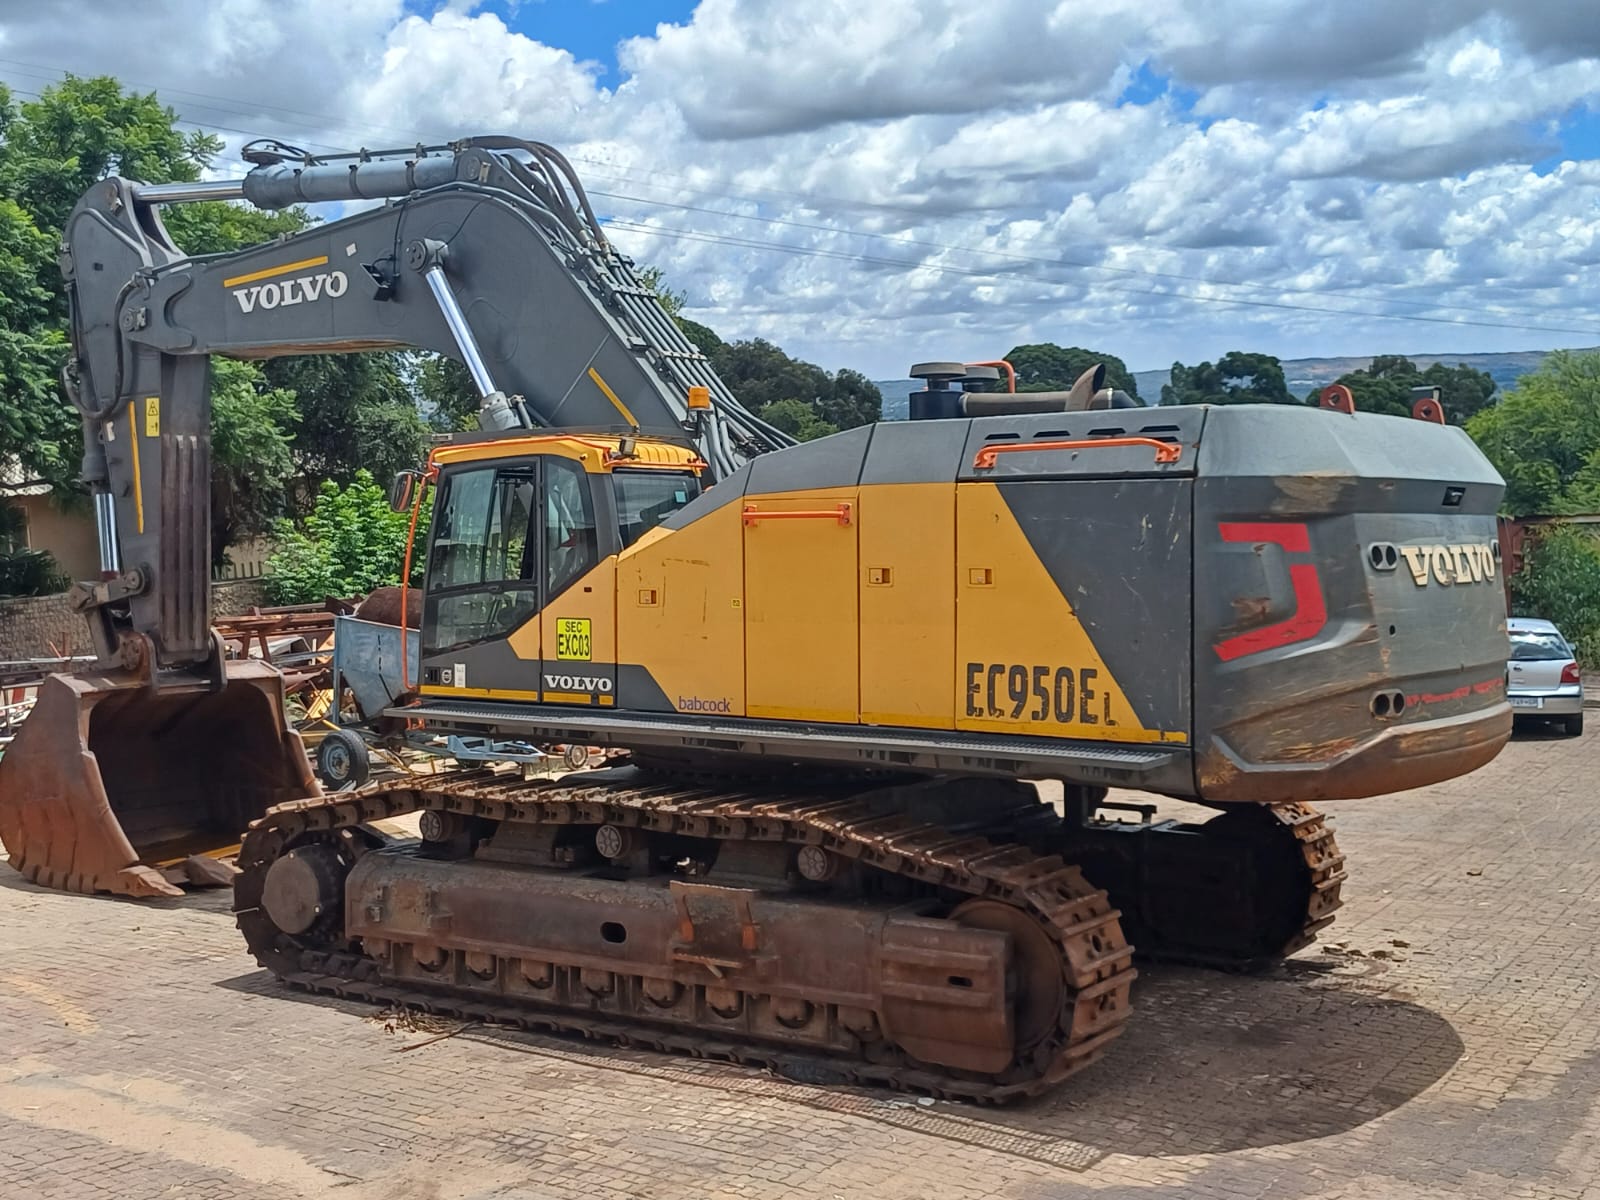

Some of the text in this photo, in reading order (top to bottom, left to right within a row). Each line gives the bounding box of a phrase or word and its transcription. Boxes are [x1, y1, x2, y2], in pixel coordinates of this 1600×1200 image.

[232, 271, 348, 313] VOLVO
[1400, 543, 1496, 586] VOLVO
[565, 621, 582, 633] SEC
[558, 633, 590, 656] EXC03
[543, 674, 612, 692] VOLVO
[678, 695, 731, 712] babcock
